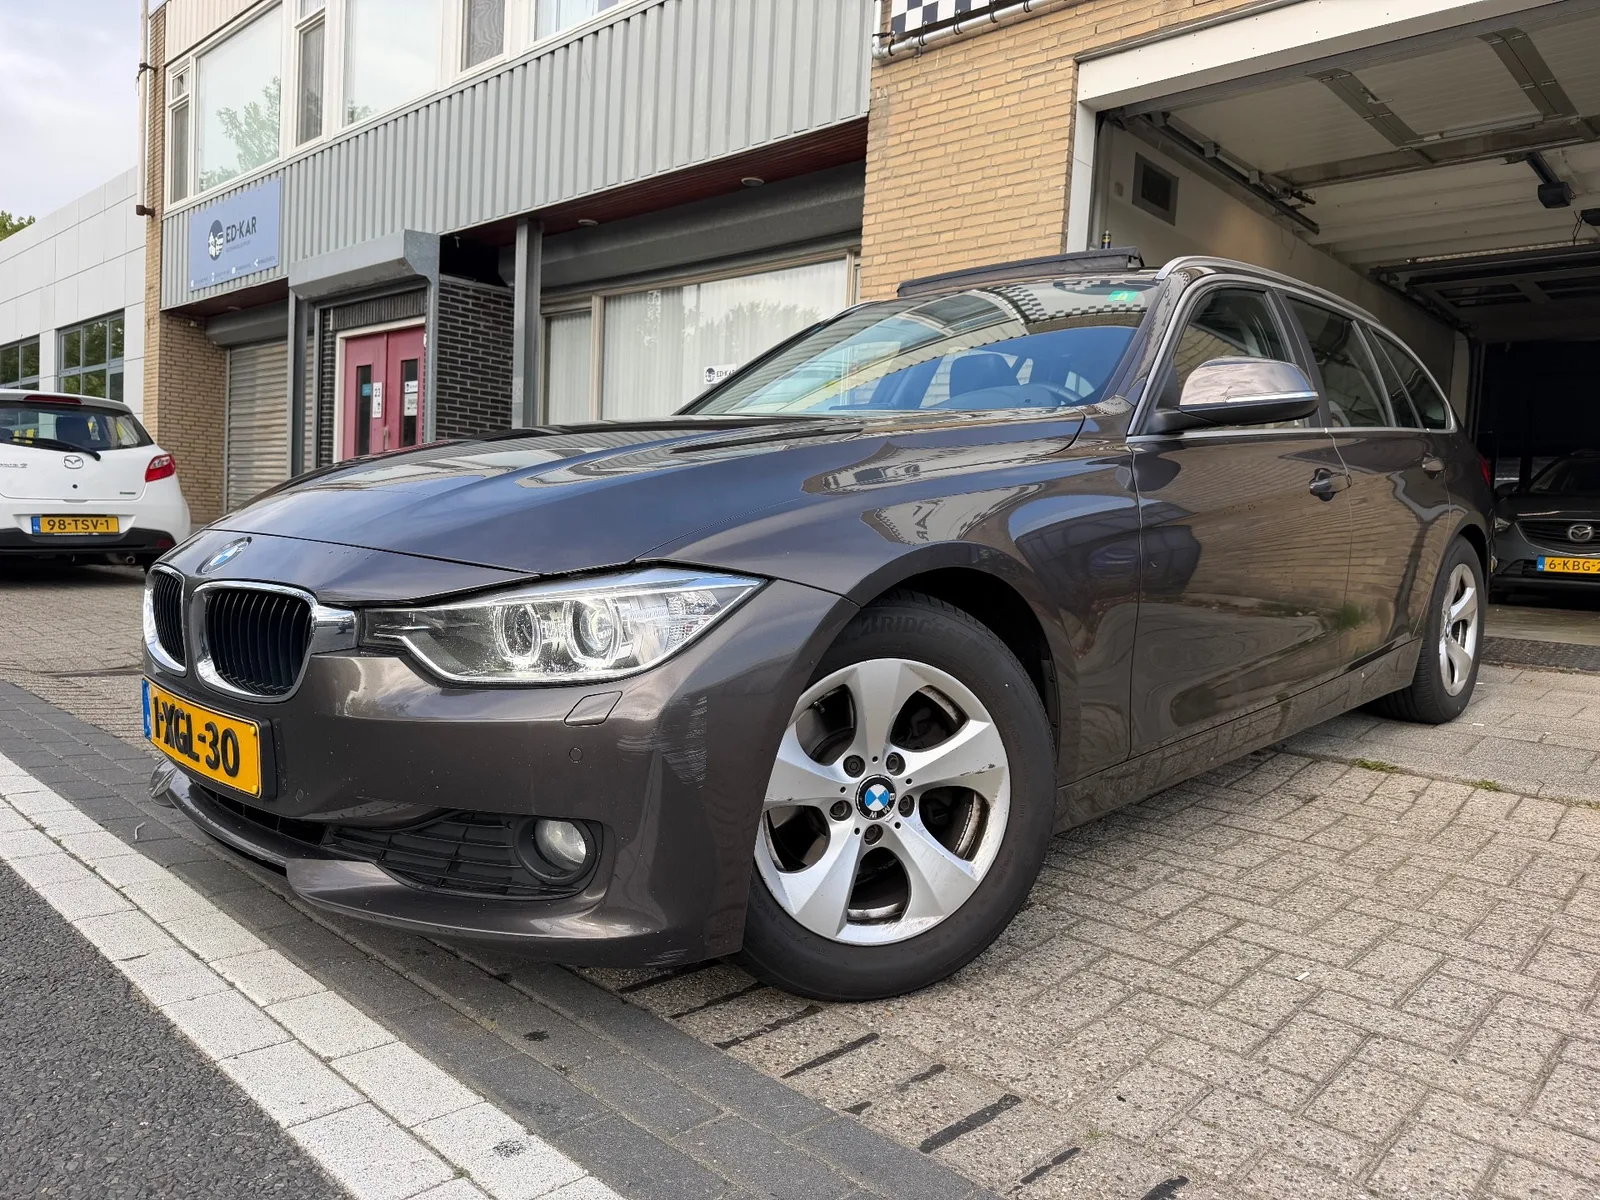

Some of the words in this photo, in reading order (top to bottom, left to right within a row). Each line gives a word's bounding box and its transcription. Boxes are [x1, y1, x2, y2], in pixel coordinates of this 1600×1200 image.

[226, 216, 257, 243] ED-KAR
[374, 387, 381, 398] 23
[47, 519, 110, 530] 98-TSV-1
[153, 696, 240, 778] 1-XGL-30
